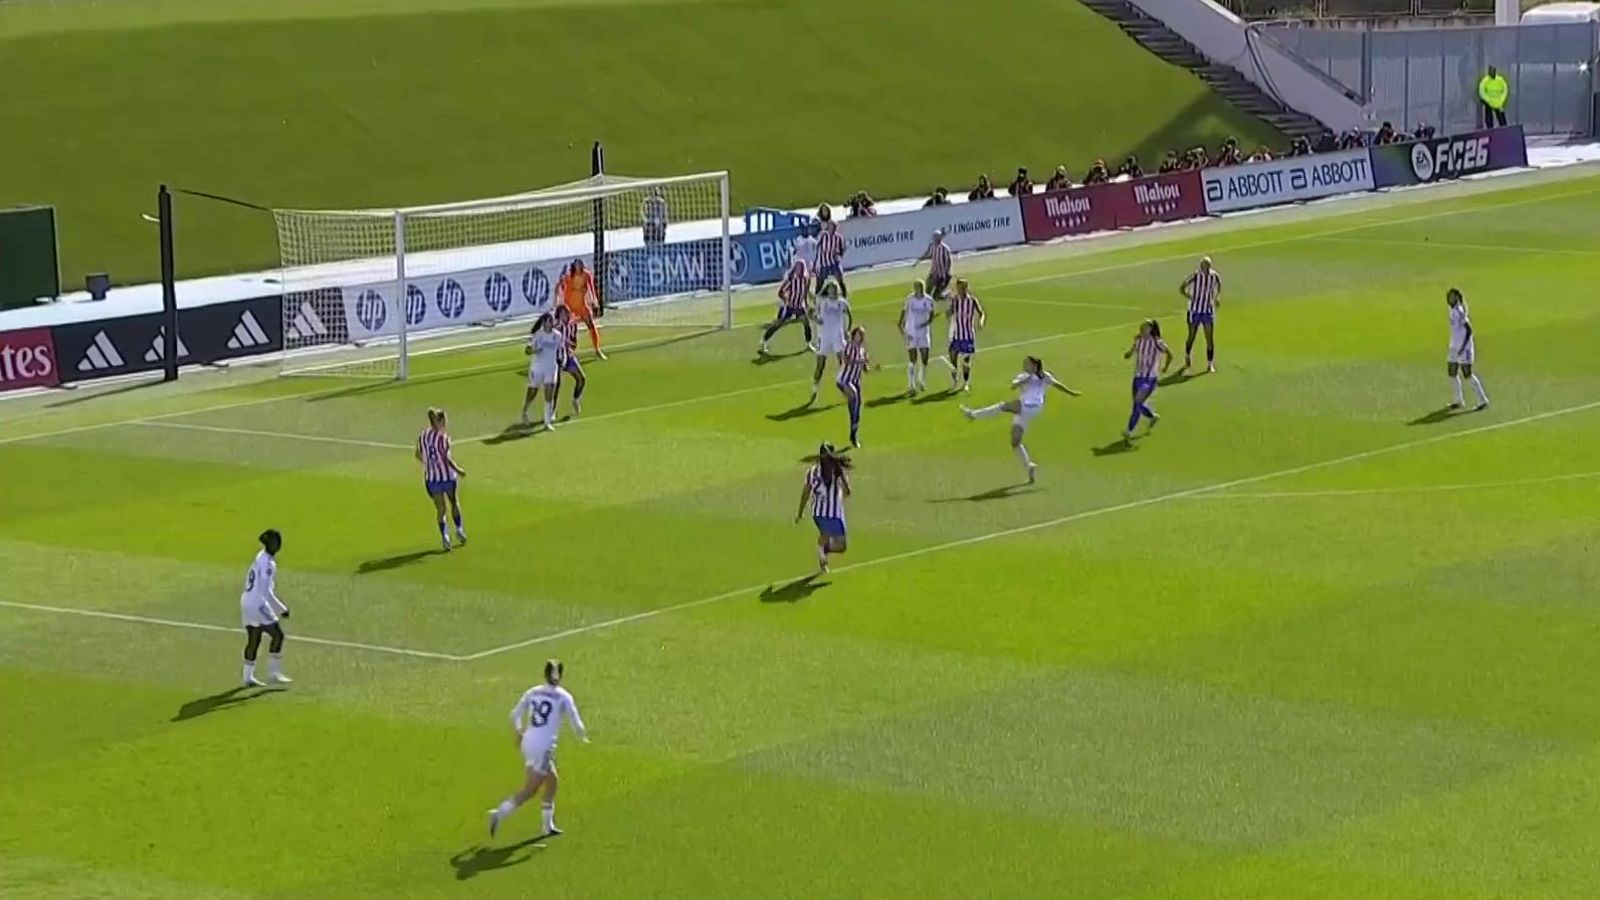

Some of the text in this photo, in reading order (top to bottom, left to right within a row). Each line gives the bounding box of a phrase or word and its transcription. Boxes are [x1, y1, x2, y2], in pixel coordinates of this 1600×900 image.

[1228, 169, 1284, 199] ABBOTT
[1312, 158, 1367, 187] ABBOTT
[1045, 195, 1091, 217] Mahou
[1134, 182, 1180, 204] Mahou
[854, 230, 915, 249] LINGLONG TIRE
[953, 216, 1011, 235] LINGLONG TIRE
[648, 252, 705, 286] BMW
[759, 238, 797, 270] BM
[438, 278, 463, 318] hp
[486, 272, 510, 312] hp
[524, 267, 547, 307] hp
[358, 289, 384, 331] hp
[0, 344, 52, 380] tes
